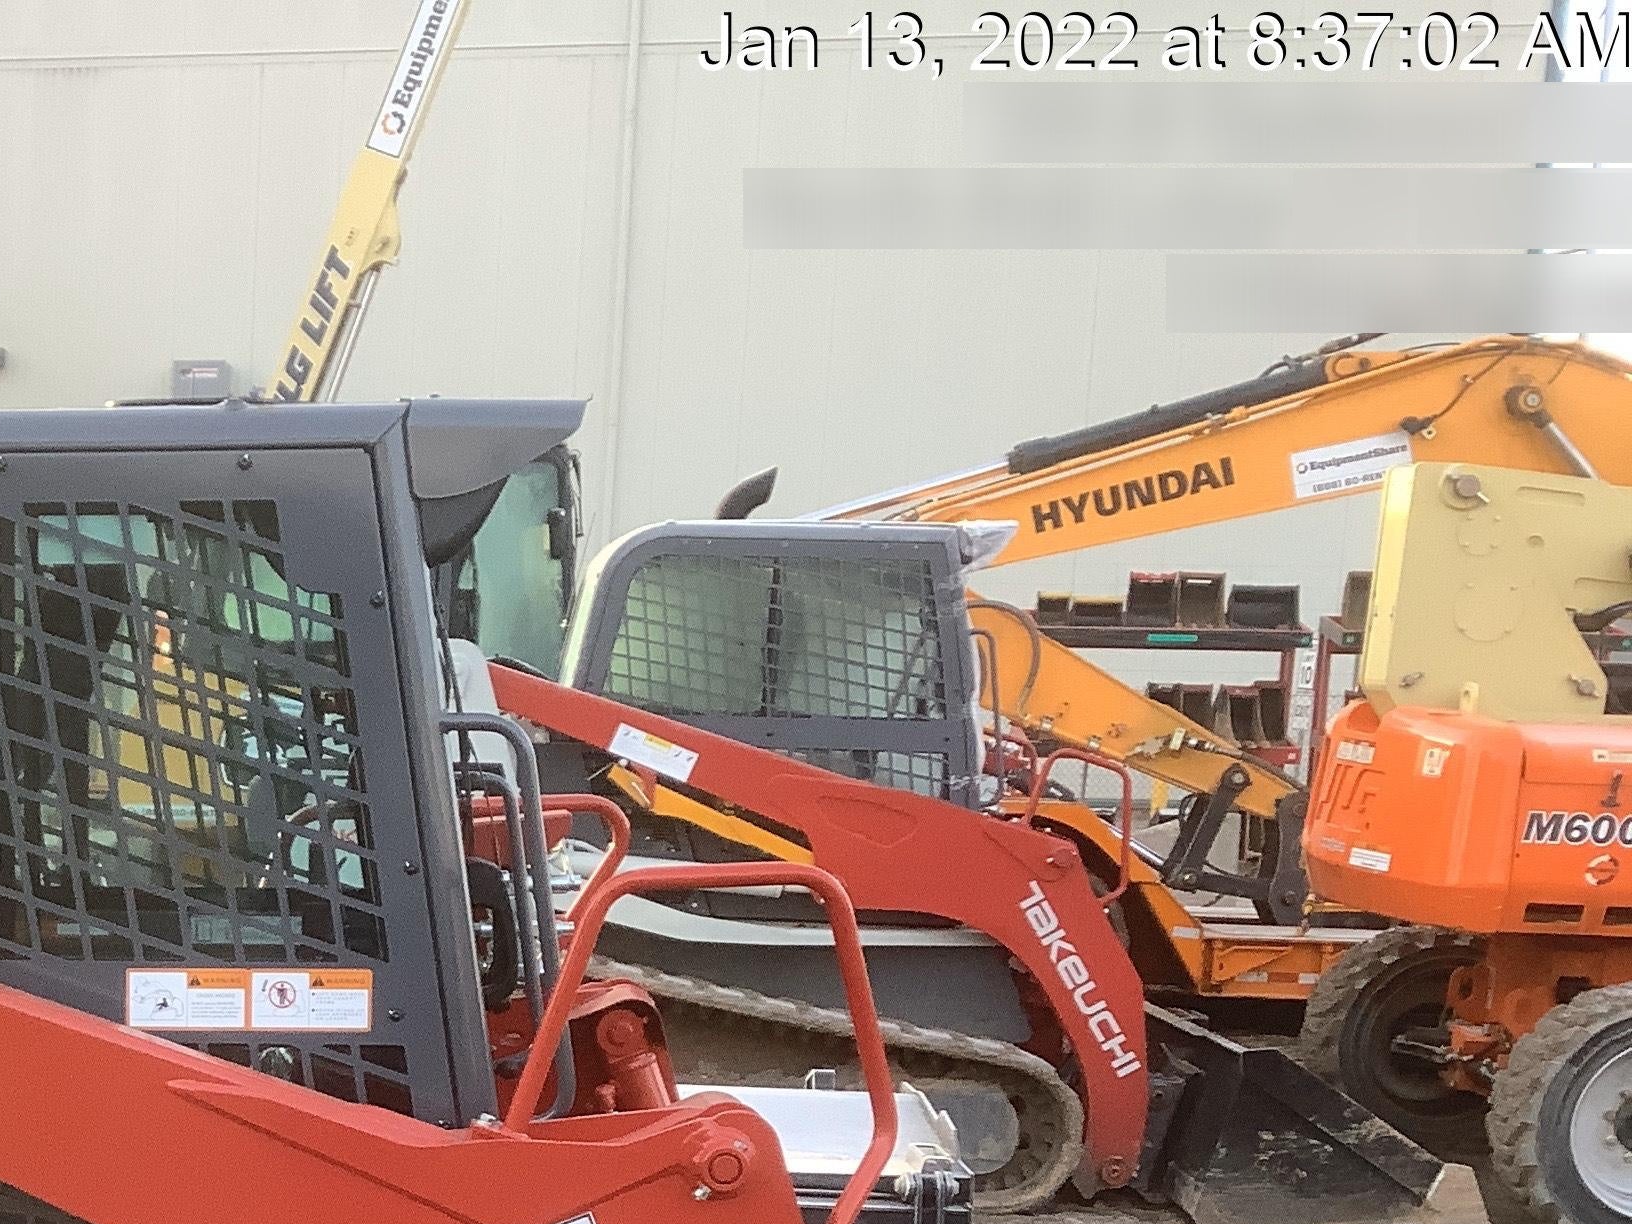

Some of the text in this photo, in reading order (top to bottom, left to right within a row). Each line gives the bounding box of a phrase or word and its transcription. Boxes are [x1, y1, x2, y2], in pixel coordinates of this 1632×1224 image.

[392, 0, 449, 108] Equipme
[272, 243, 350, 401] LG LIFT
[1030, 456, 1236, 534] HYUNDAI
[1309, 444, 1407, 471] EquipmentShare
[1019, 880, 1141, 1078] TAKEUCHI
